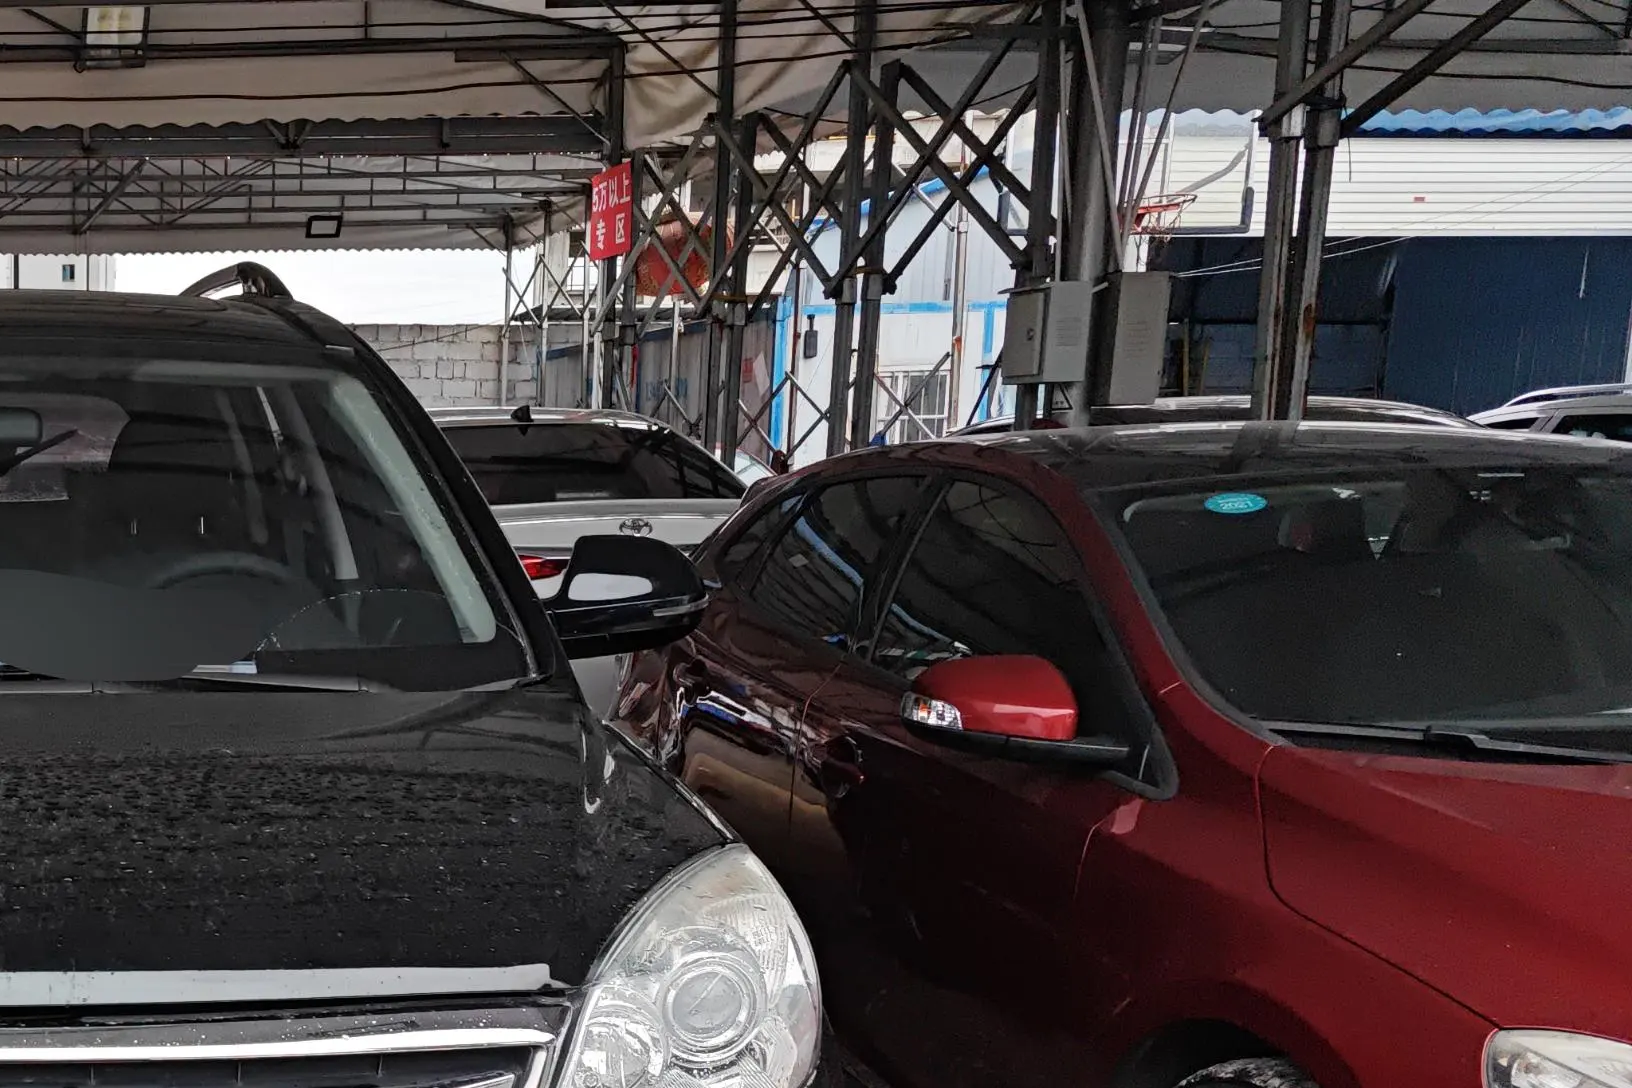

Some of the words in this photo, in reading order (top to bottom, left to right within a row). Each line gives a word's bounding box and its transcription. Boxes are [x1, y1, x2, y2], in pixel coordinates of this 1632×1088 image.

[592, 172, 630, 212] 5万以上
[596, 213, 625, 249] 专区
